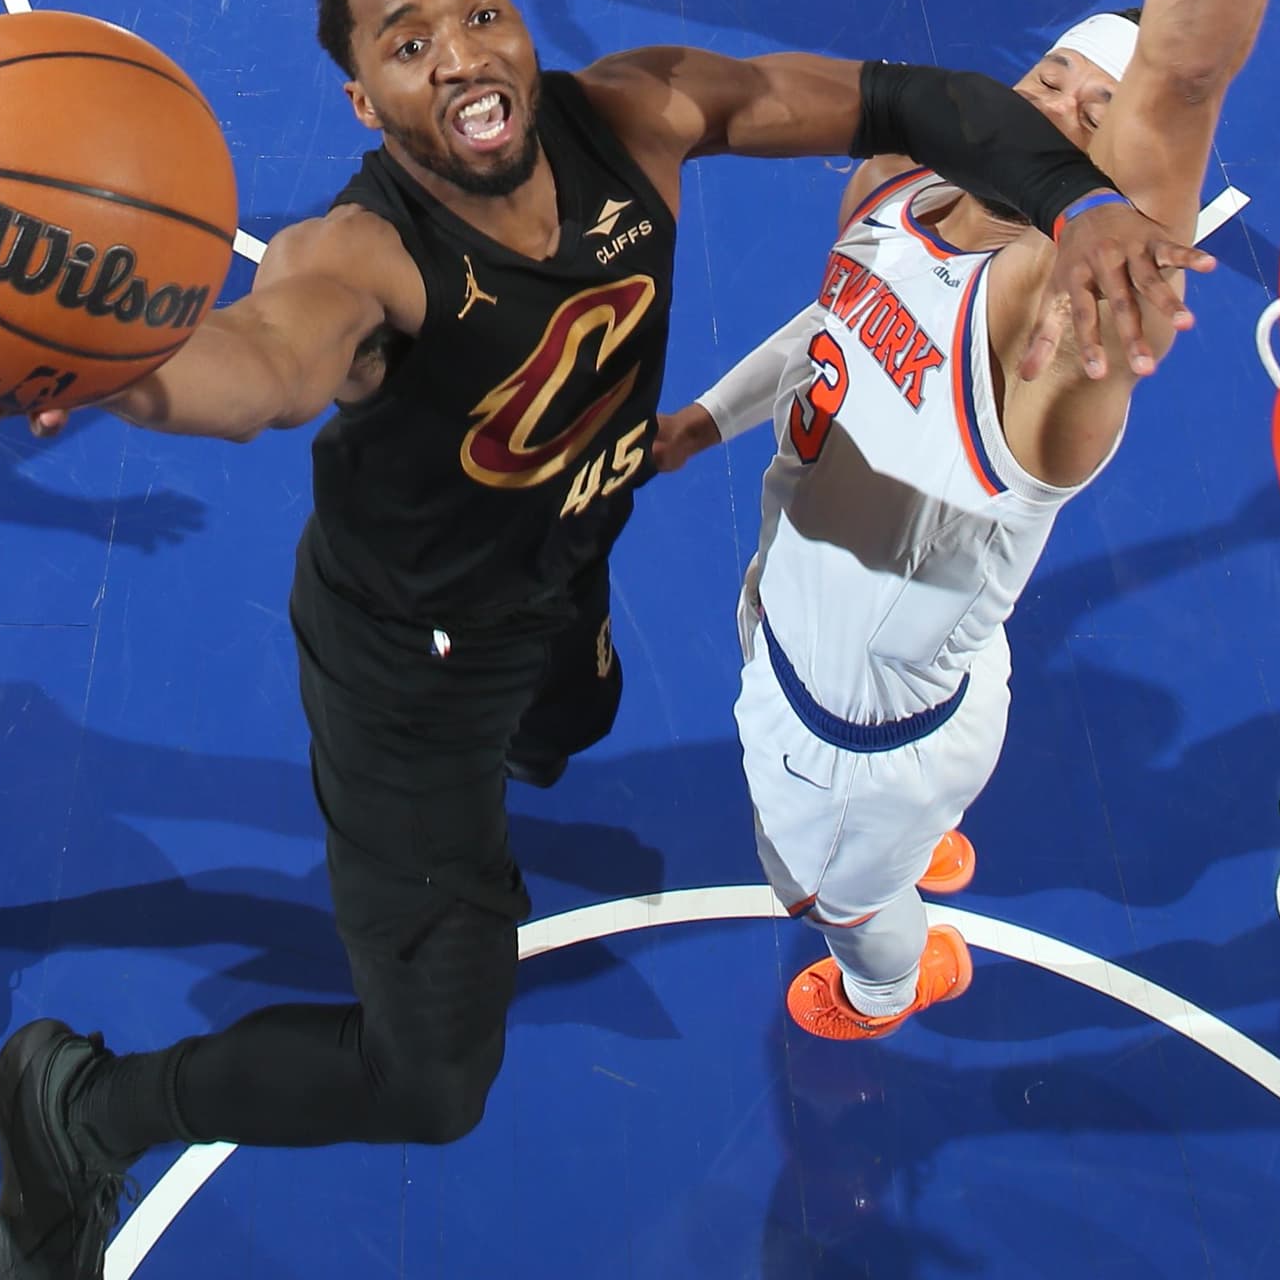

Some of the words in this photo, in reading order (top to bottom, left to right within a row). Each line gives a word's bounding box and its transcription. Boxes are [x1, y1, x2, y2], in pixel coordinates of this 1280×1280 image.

[594, 219, 653, 266] CLIFFS
[789, 328, 850, 465] 3
[559, 419, 649, 520] 45
